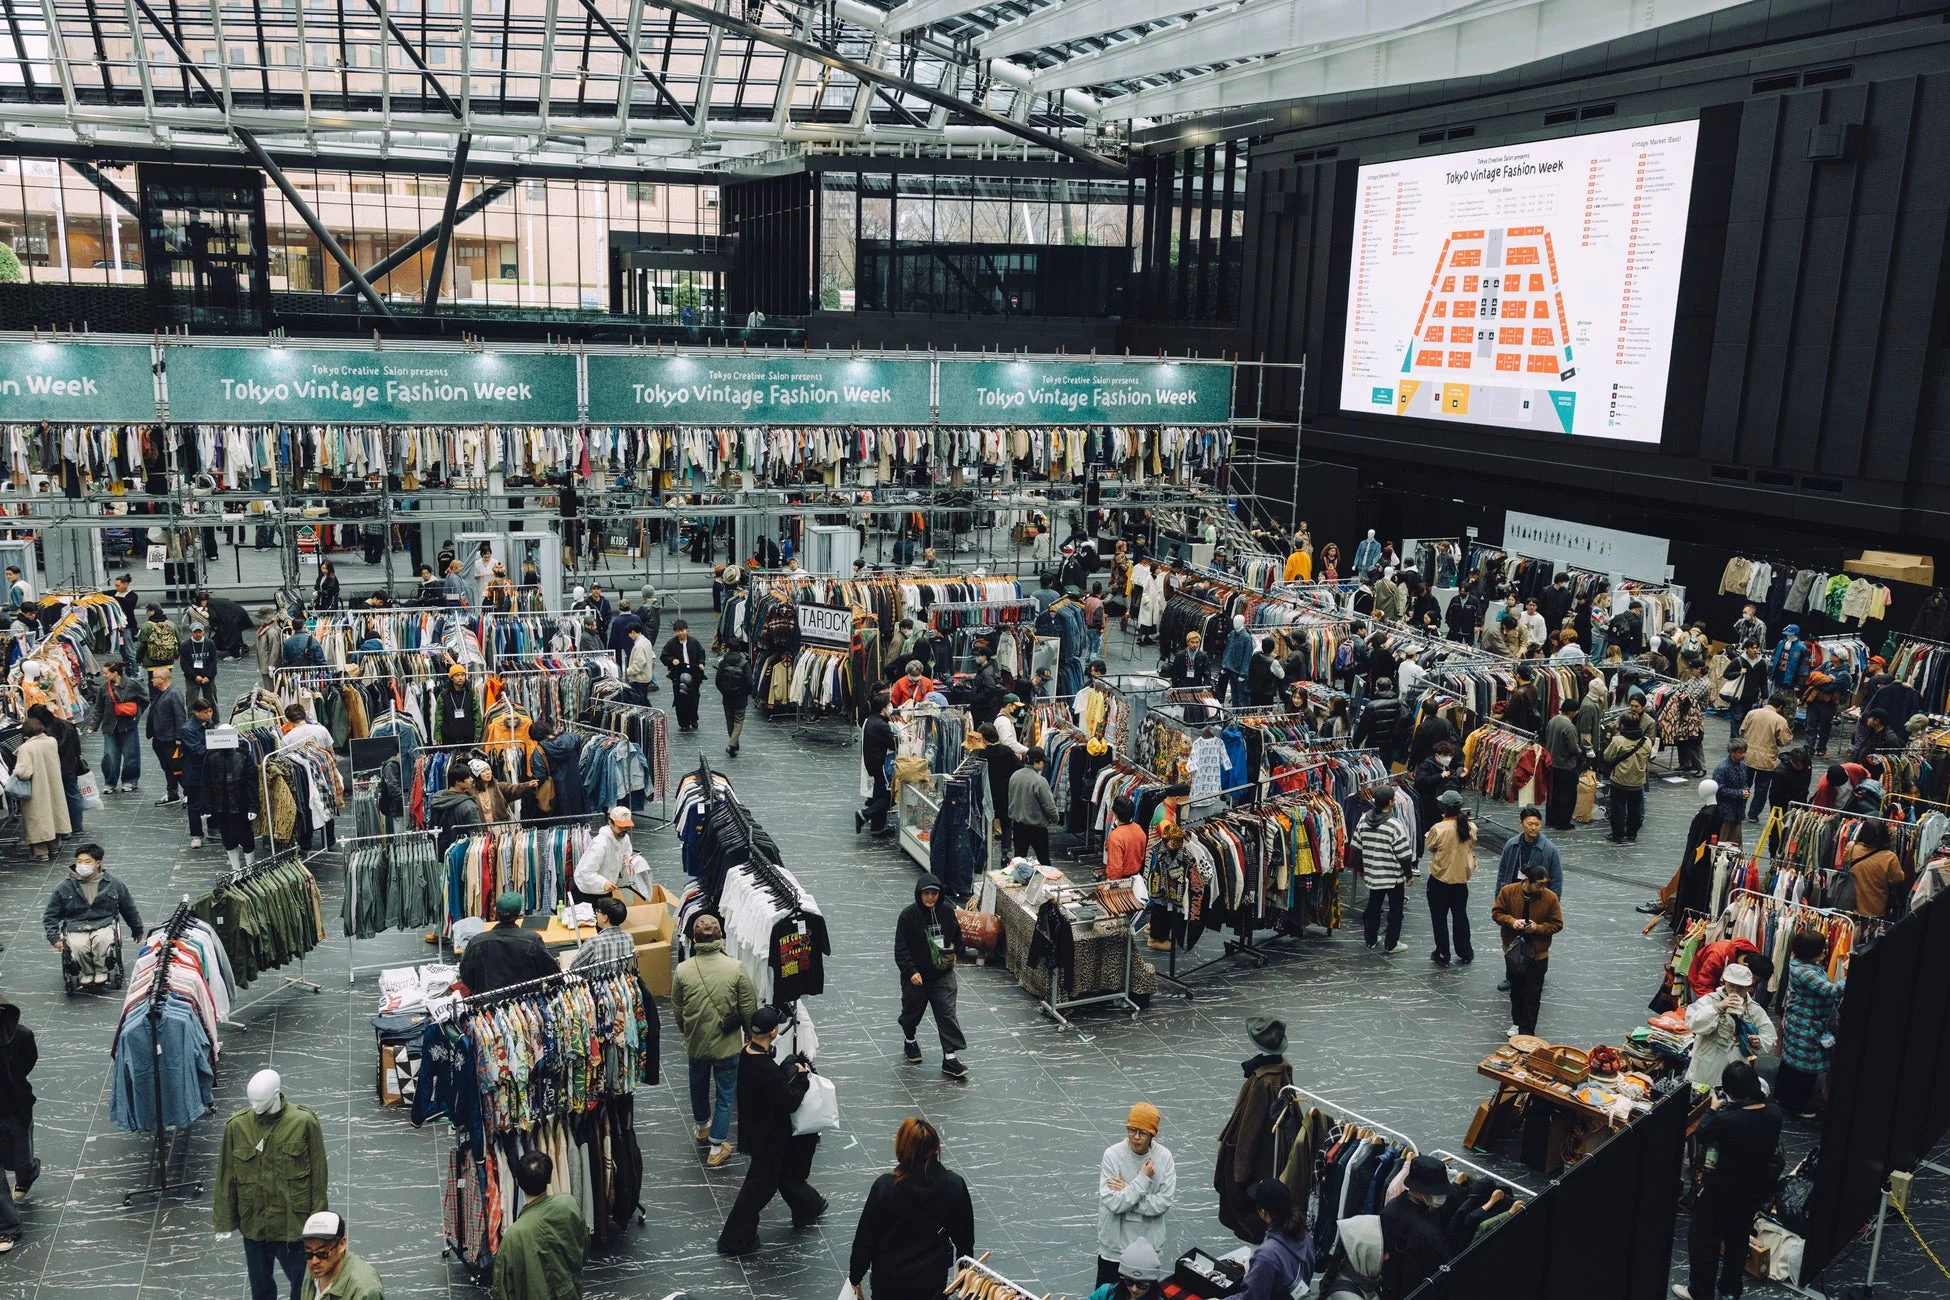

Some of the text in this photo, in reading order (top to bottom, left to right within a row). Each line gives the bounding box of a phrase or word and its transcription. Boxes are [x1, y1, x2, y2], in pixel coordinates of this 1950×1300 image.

[1446, 159, 1564, 184] Tokyo Vintage Fashion Week
[312, 364, 449, 377] Tokyo Creative Salon presents
[709, 370, 823, 382] Tokyo Creative Salon presents
[1042, 375, 1139, 386] Tokyo Creative Salon presents
[0, 374, 99, 397] n Week
[221, 378, 532, 408] Tokyo Vintage Fashion Week
[632, 383, 892, 410] Tokyo Vintage Fashion Week
[977, 387, 1197, 412] Tokyo Vintage Fashion Week
[610, 535, 628, 546] KIDS
[801, 607, 849, 633] TAROCK
